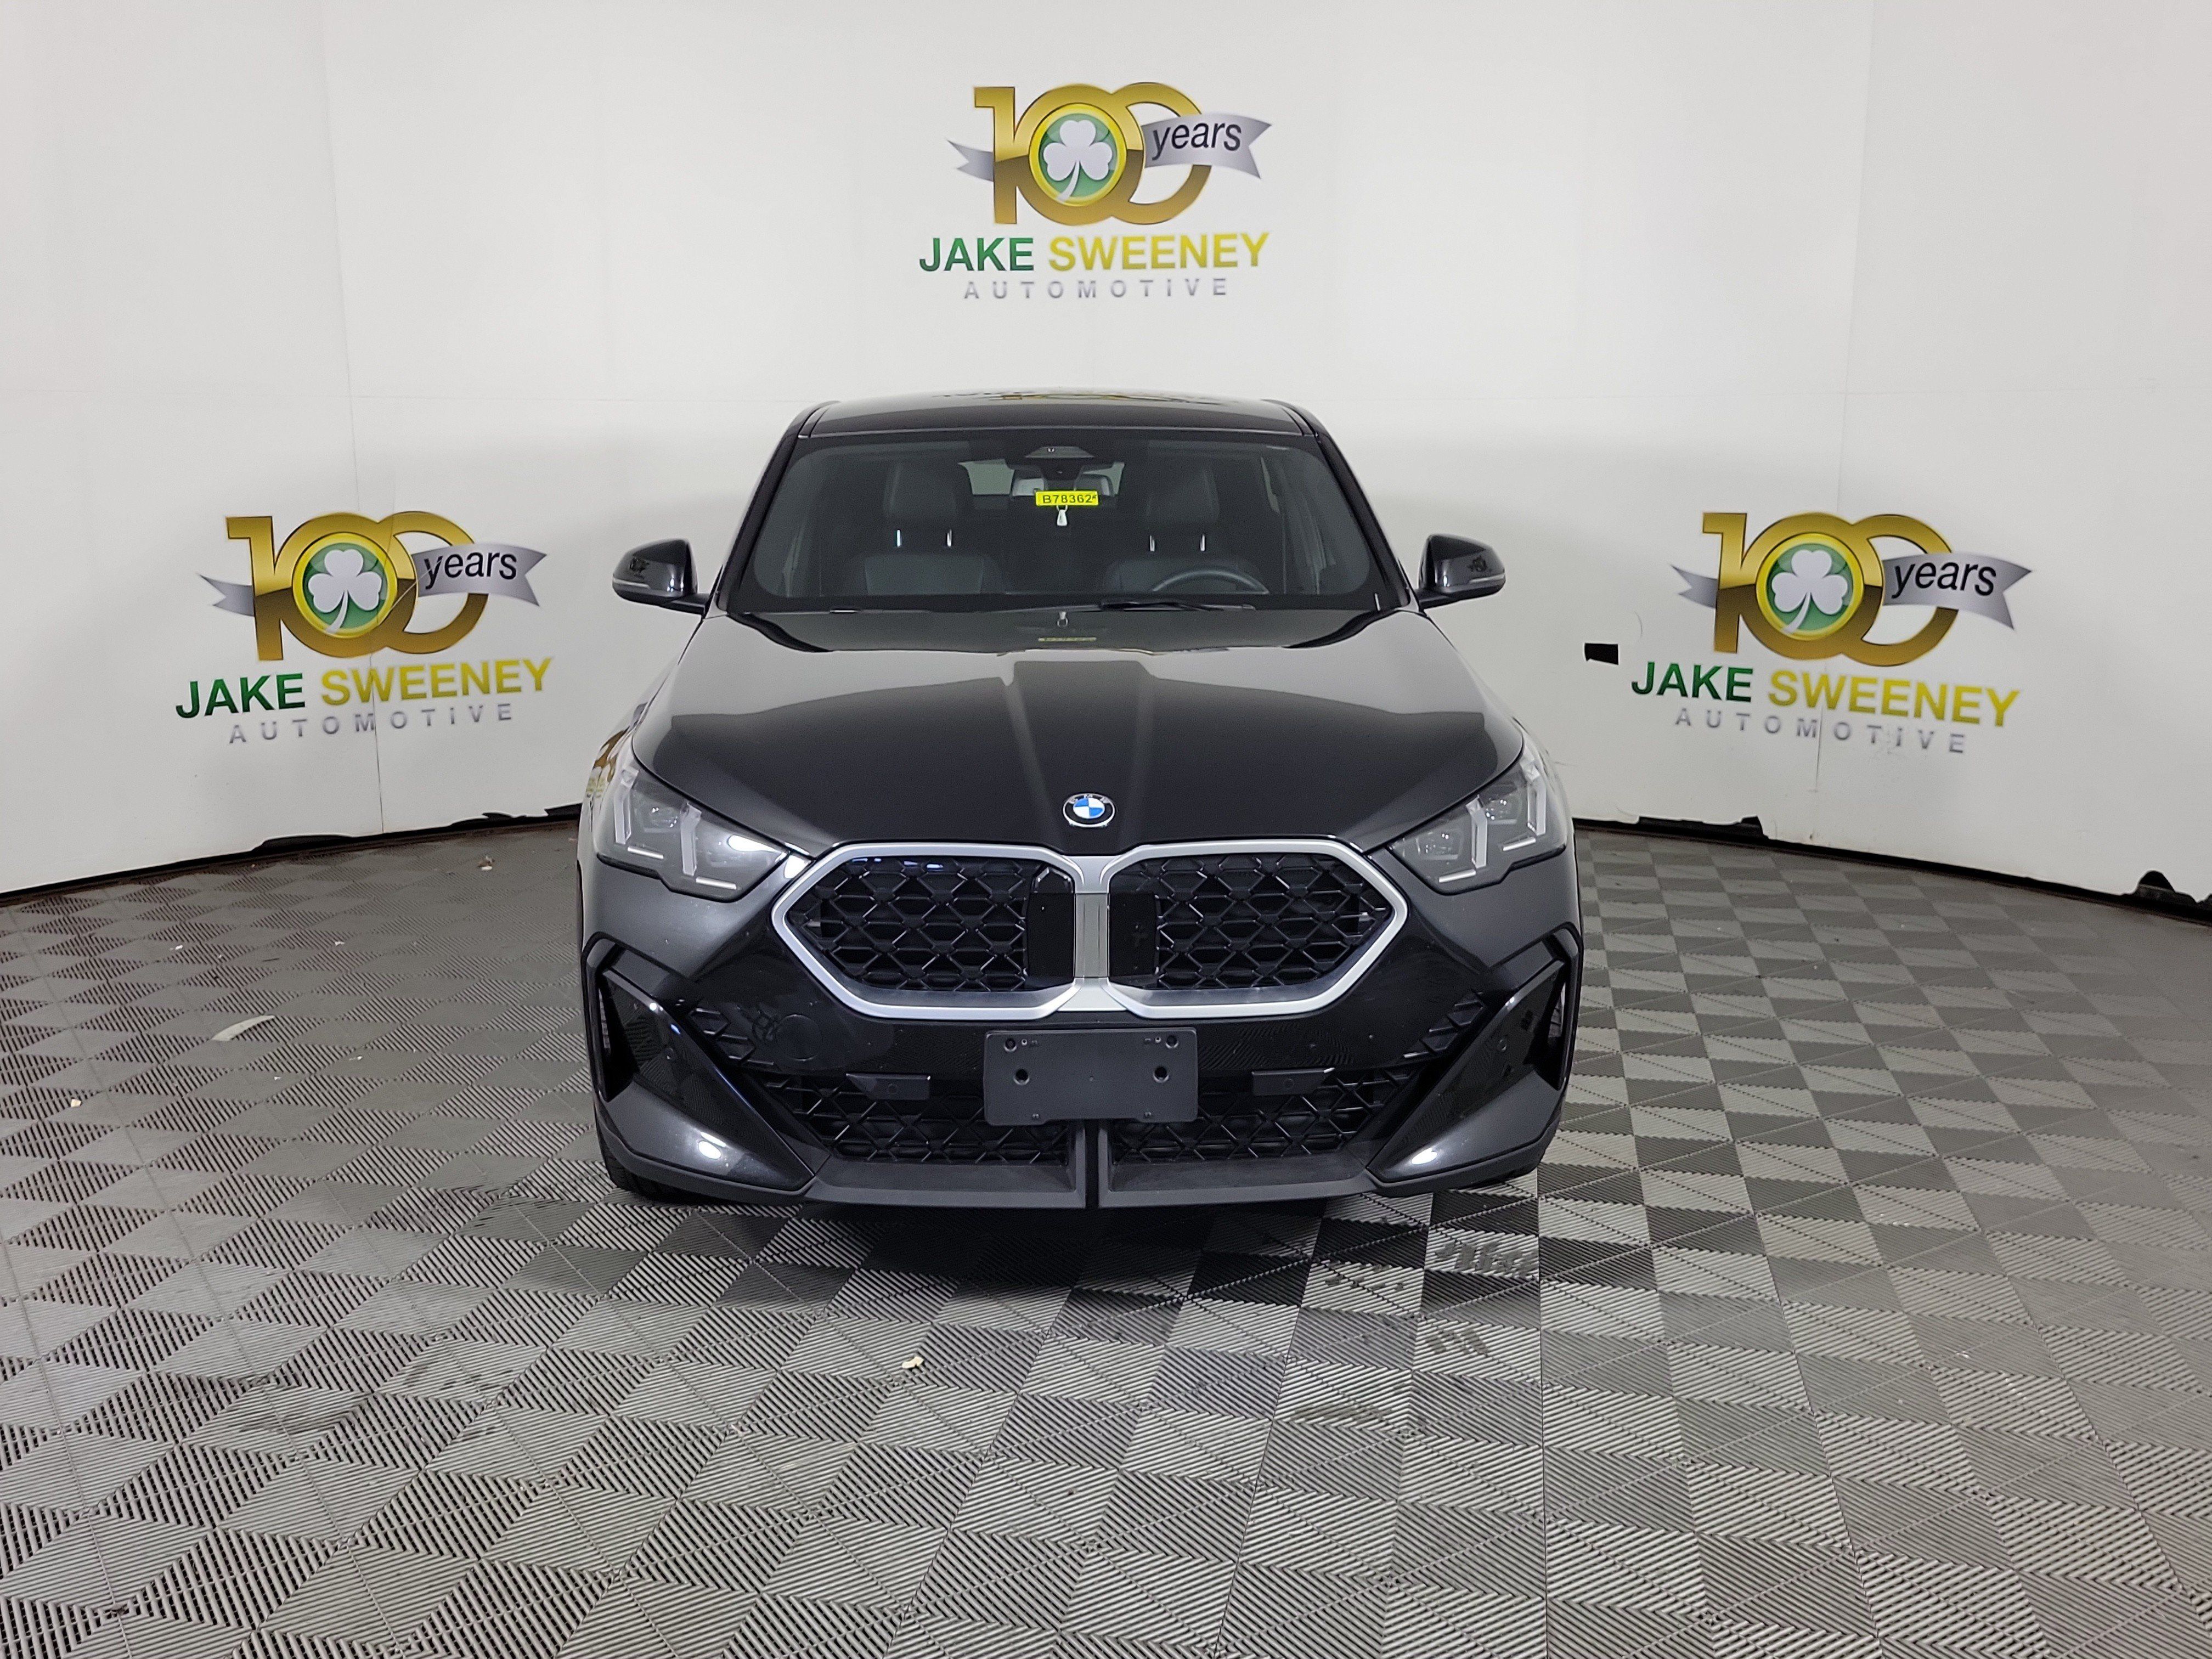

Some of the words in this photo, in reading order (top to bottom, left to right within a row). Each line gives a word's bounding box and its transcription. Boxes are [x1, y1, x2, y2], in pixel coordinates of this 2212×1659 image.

[974, 82, 1211, 225] 100
[1152, 122, 1243, 160] years
[919, 237, 1034, 272] JAKE
[1048, 233, 1269, 272] SWEENEY
[964, 278, 1226, 300] AUTOMOTIVE
[225, 511, 489, 660] 100
[423, 550, 517, 589] years
[1702, 511, 1959, 667] 100
[1892, 560, 1996, 599] years
[175, 673, 306, 719] JAKE
[321, 657, 554, 706] SWEENEY
[1631, 661, 1753, 703] JAKE
[1767, 669, 2020, 727] SWEENEY
[229, 703, 512, 743] AUTOMOTIVE
[1674, 708, 1966, 753] AUTOMOTIVE
